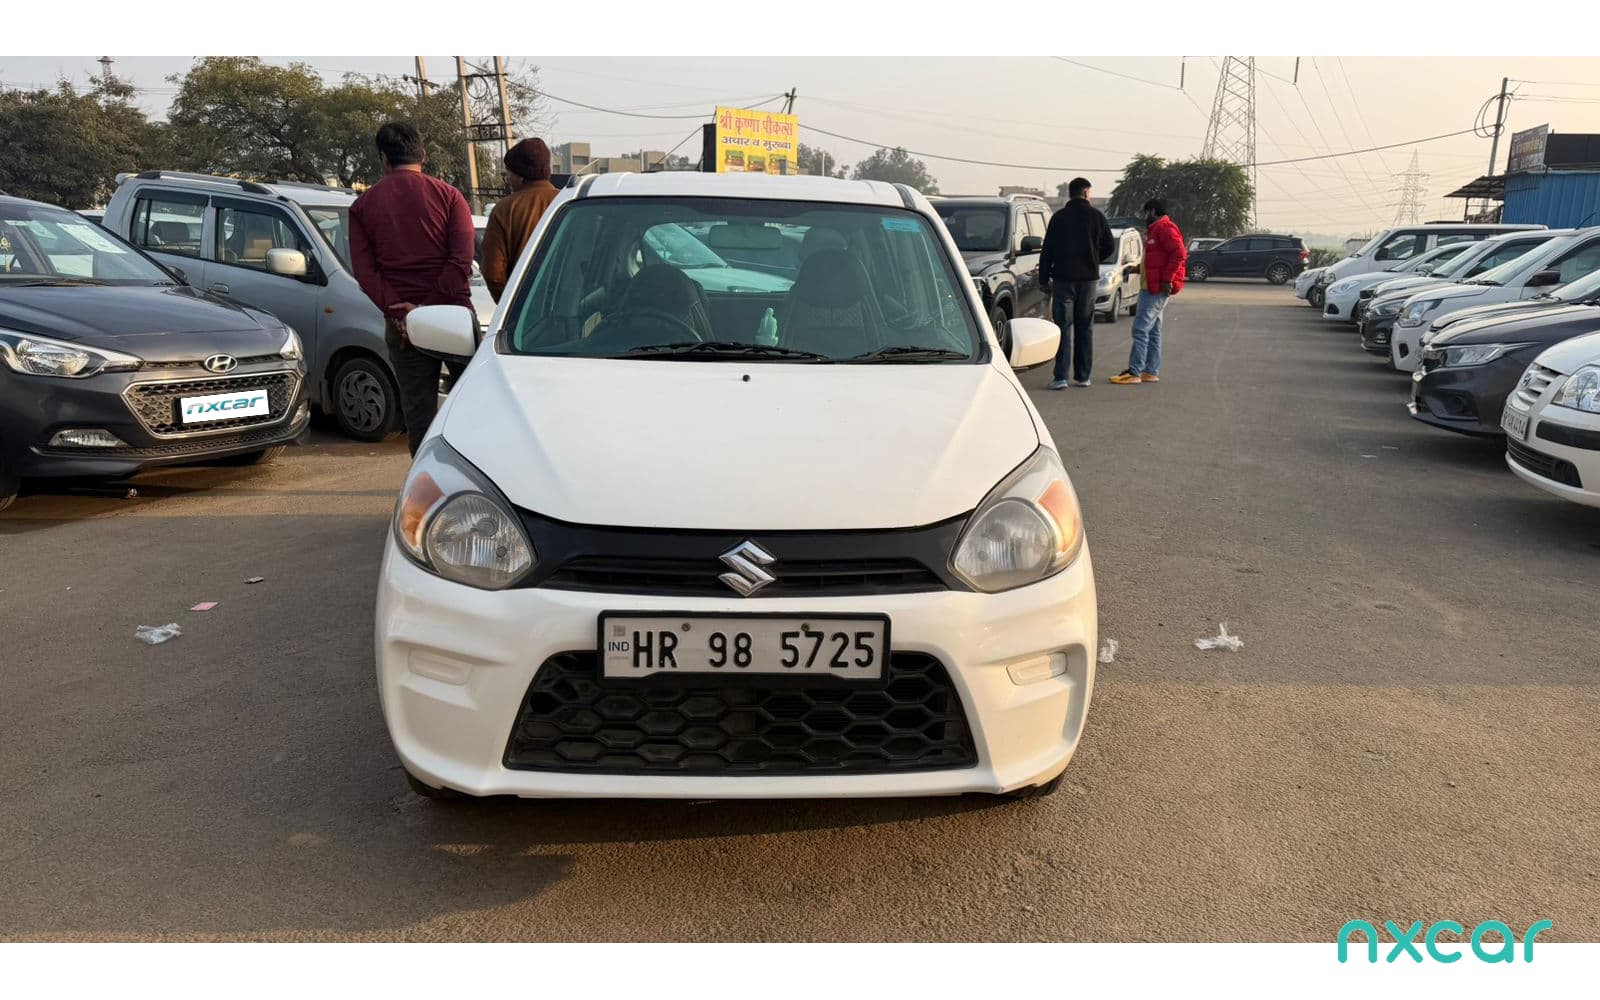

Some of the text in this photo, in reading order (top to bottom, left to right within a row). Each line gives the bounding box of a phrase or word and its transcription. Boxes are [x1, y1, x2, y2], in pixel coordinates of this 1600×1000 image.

[720, 110, 732, 130] श्री
[721, 136, 750, 146] अचार
[186, 395, 265, 415] nxcar
[608, 641, 630, 652] IND
[632, 630, 875, 669] HR 98 5725
